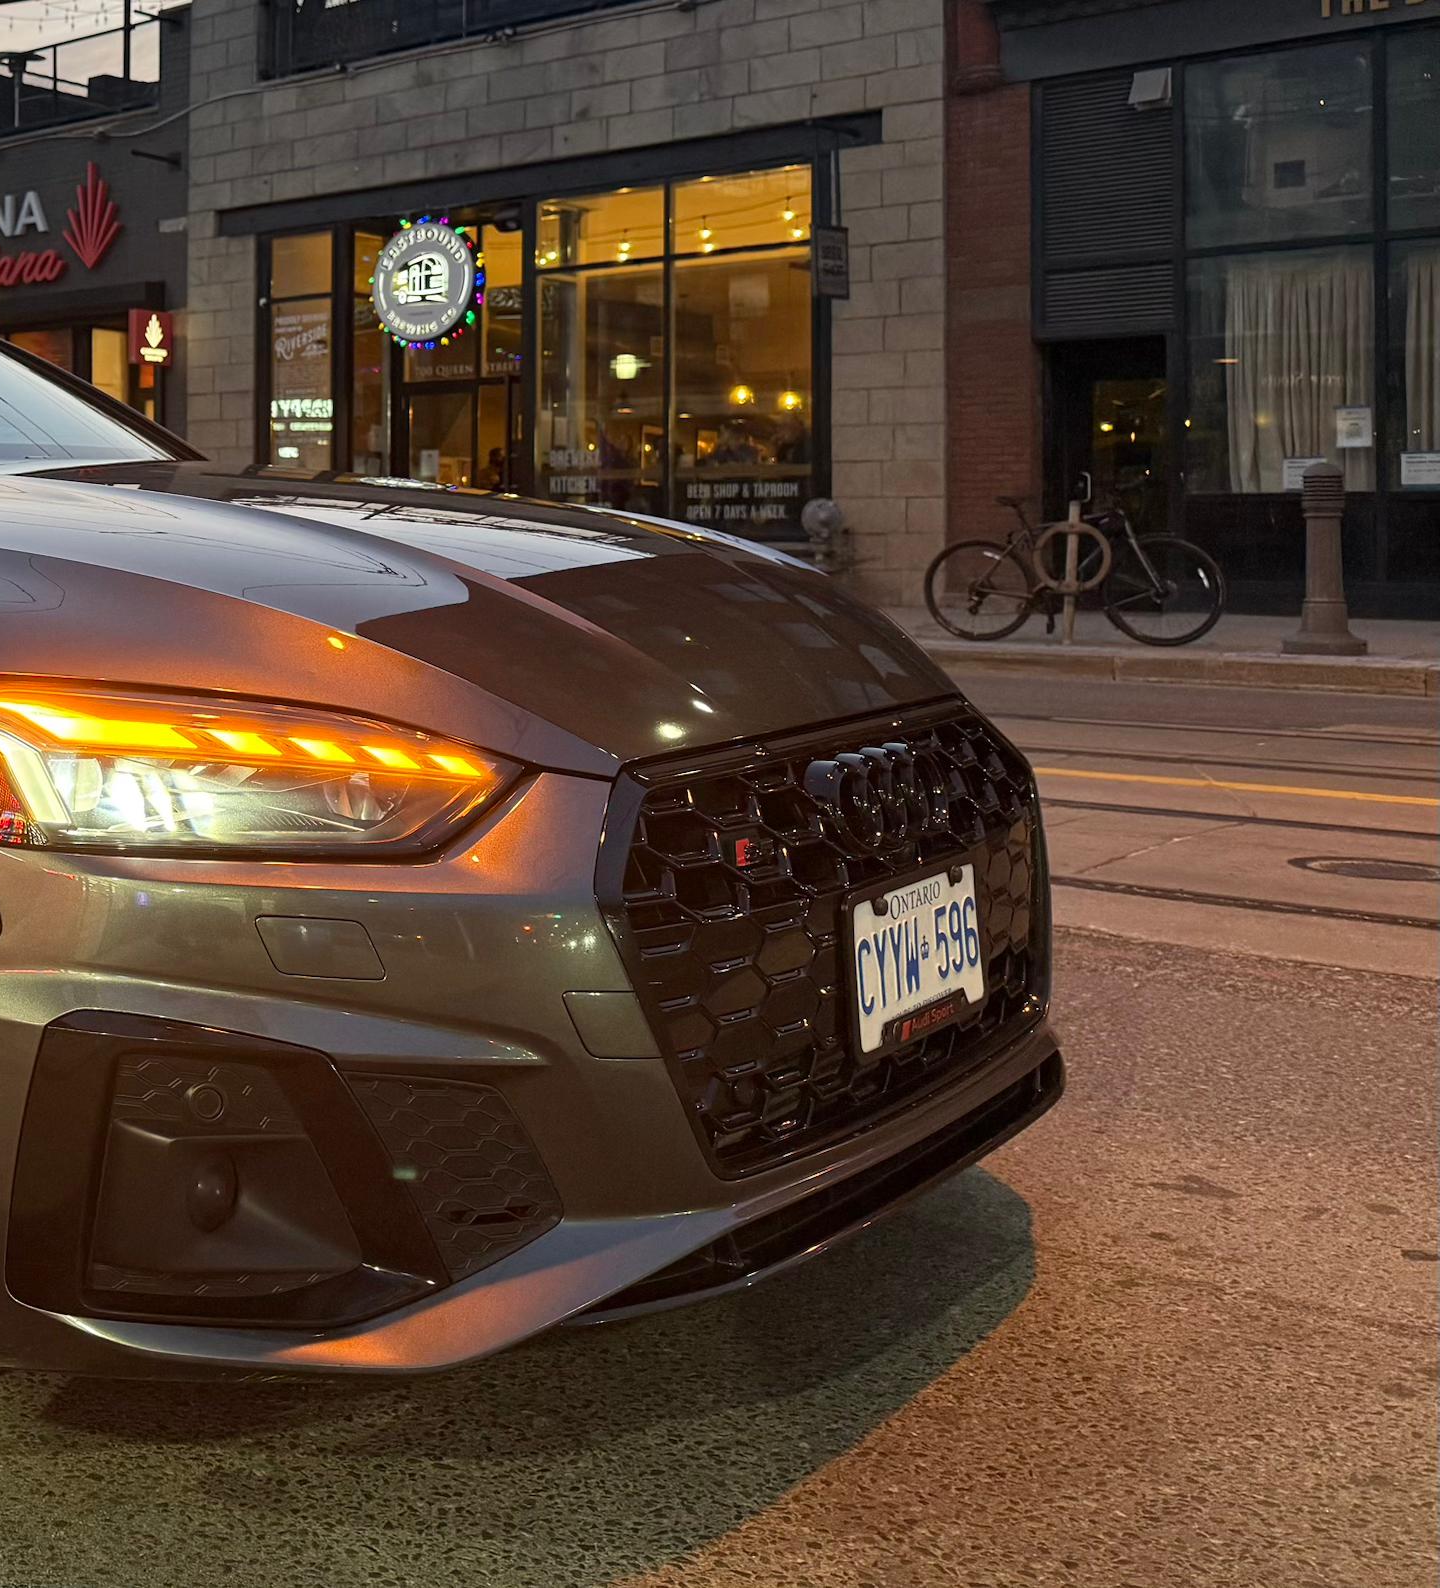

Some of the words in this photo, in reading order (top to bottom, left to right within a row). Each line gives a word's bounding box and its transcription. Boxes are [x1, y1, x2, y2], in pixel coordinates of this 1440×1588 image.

[380, 227, 467, 272] EASTBOUND
[386, 309, 439, 336] BREWING
[435, 363, 474, 377] QUEEN
[686, 484, 711, 499] BEER
[713, 483, 740, 498] SHOP
[742, 483, 751, 498] &
[753, 482, 799, 497] TAPROOM
[686, 505, 712, 520] OPEN
[723, 504, 747, 519] DAYS
[890, 881, 941, 920] ONTARIO
[857, 916, 921, 1016] CYYW
[934, 896, 979, 981] 596
[912, 1011, 931, 1030] Audi
[931, 1003, 954, 1023] Sport
